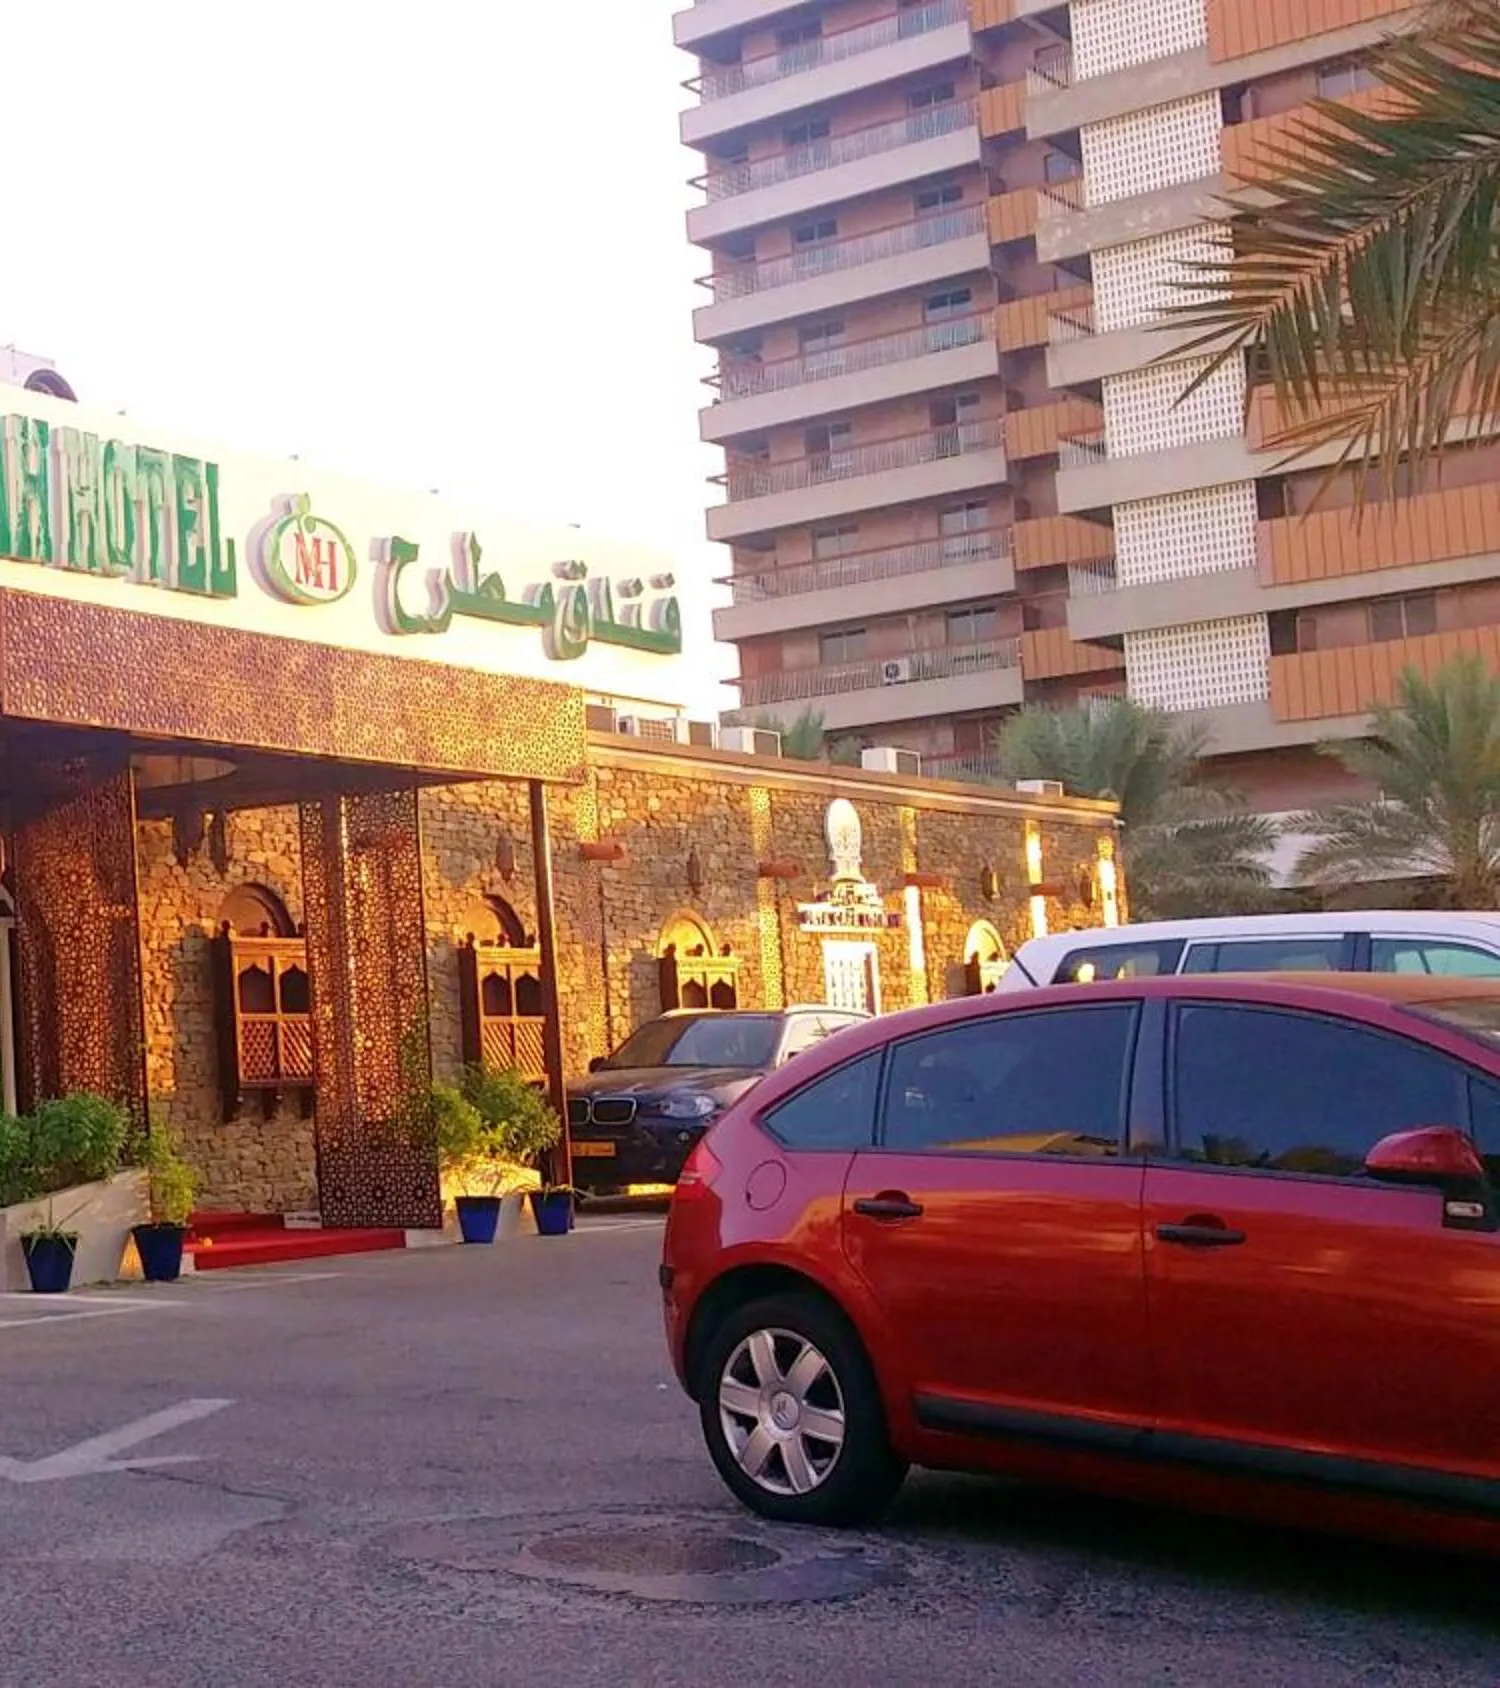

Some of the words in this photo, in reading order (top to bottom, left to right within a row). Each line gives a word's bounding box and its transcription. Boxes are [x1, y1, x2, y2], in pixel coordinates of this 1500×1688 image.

[54, 425, 239, 600] HOTEL
[293, 530, 339, 592] MH
[370, 530, 554, 636] مطرح
[544, 559, 682, 661] فندق
